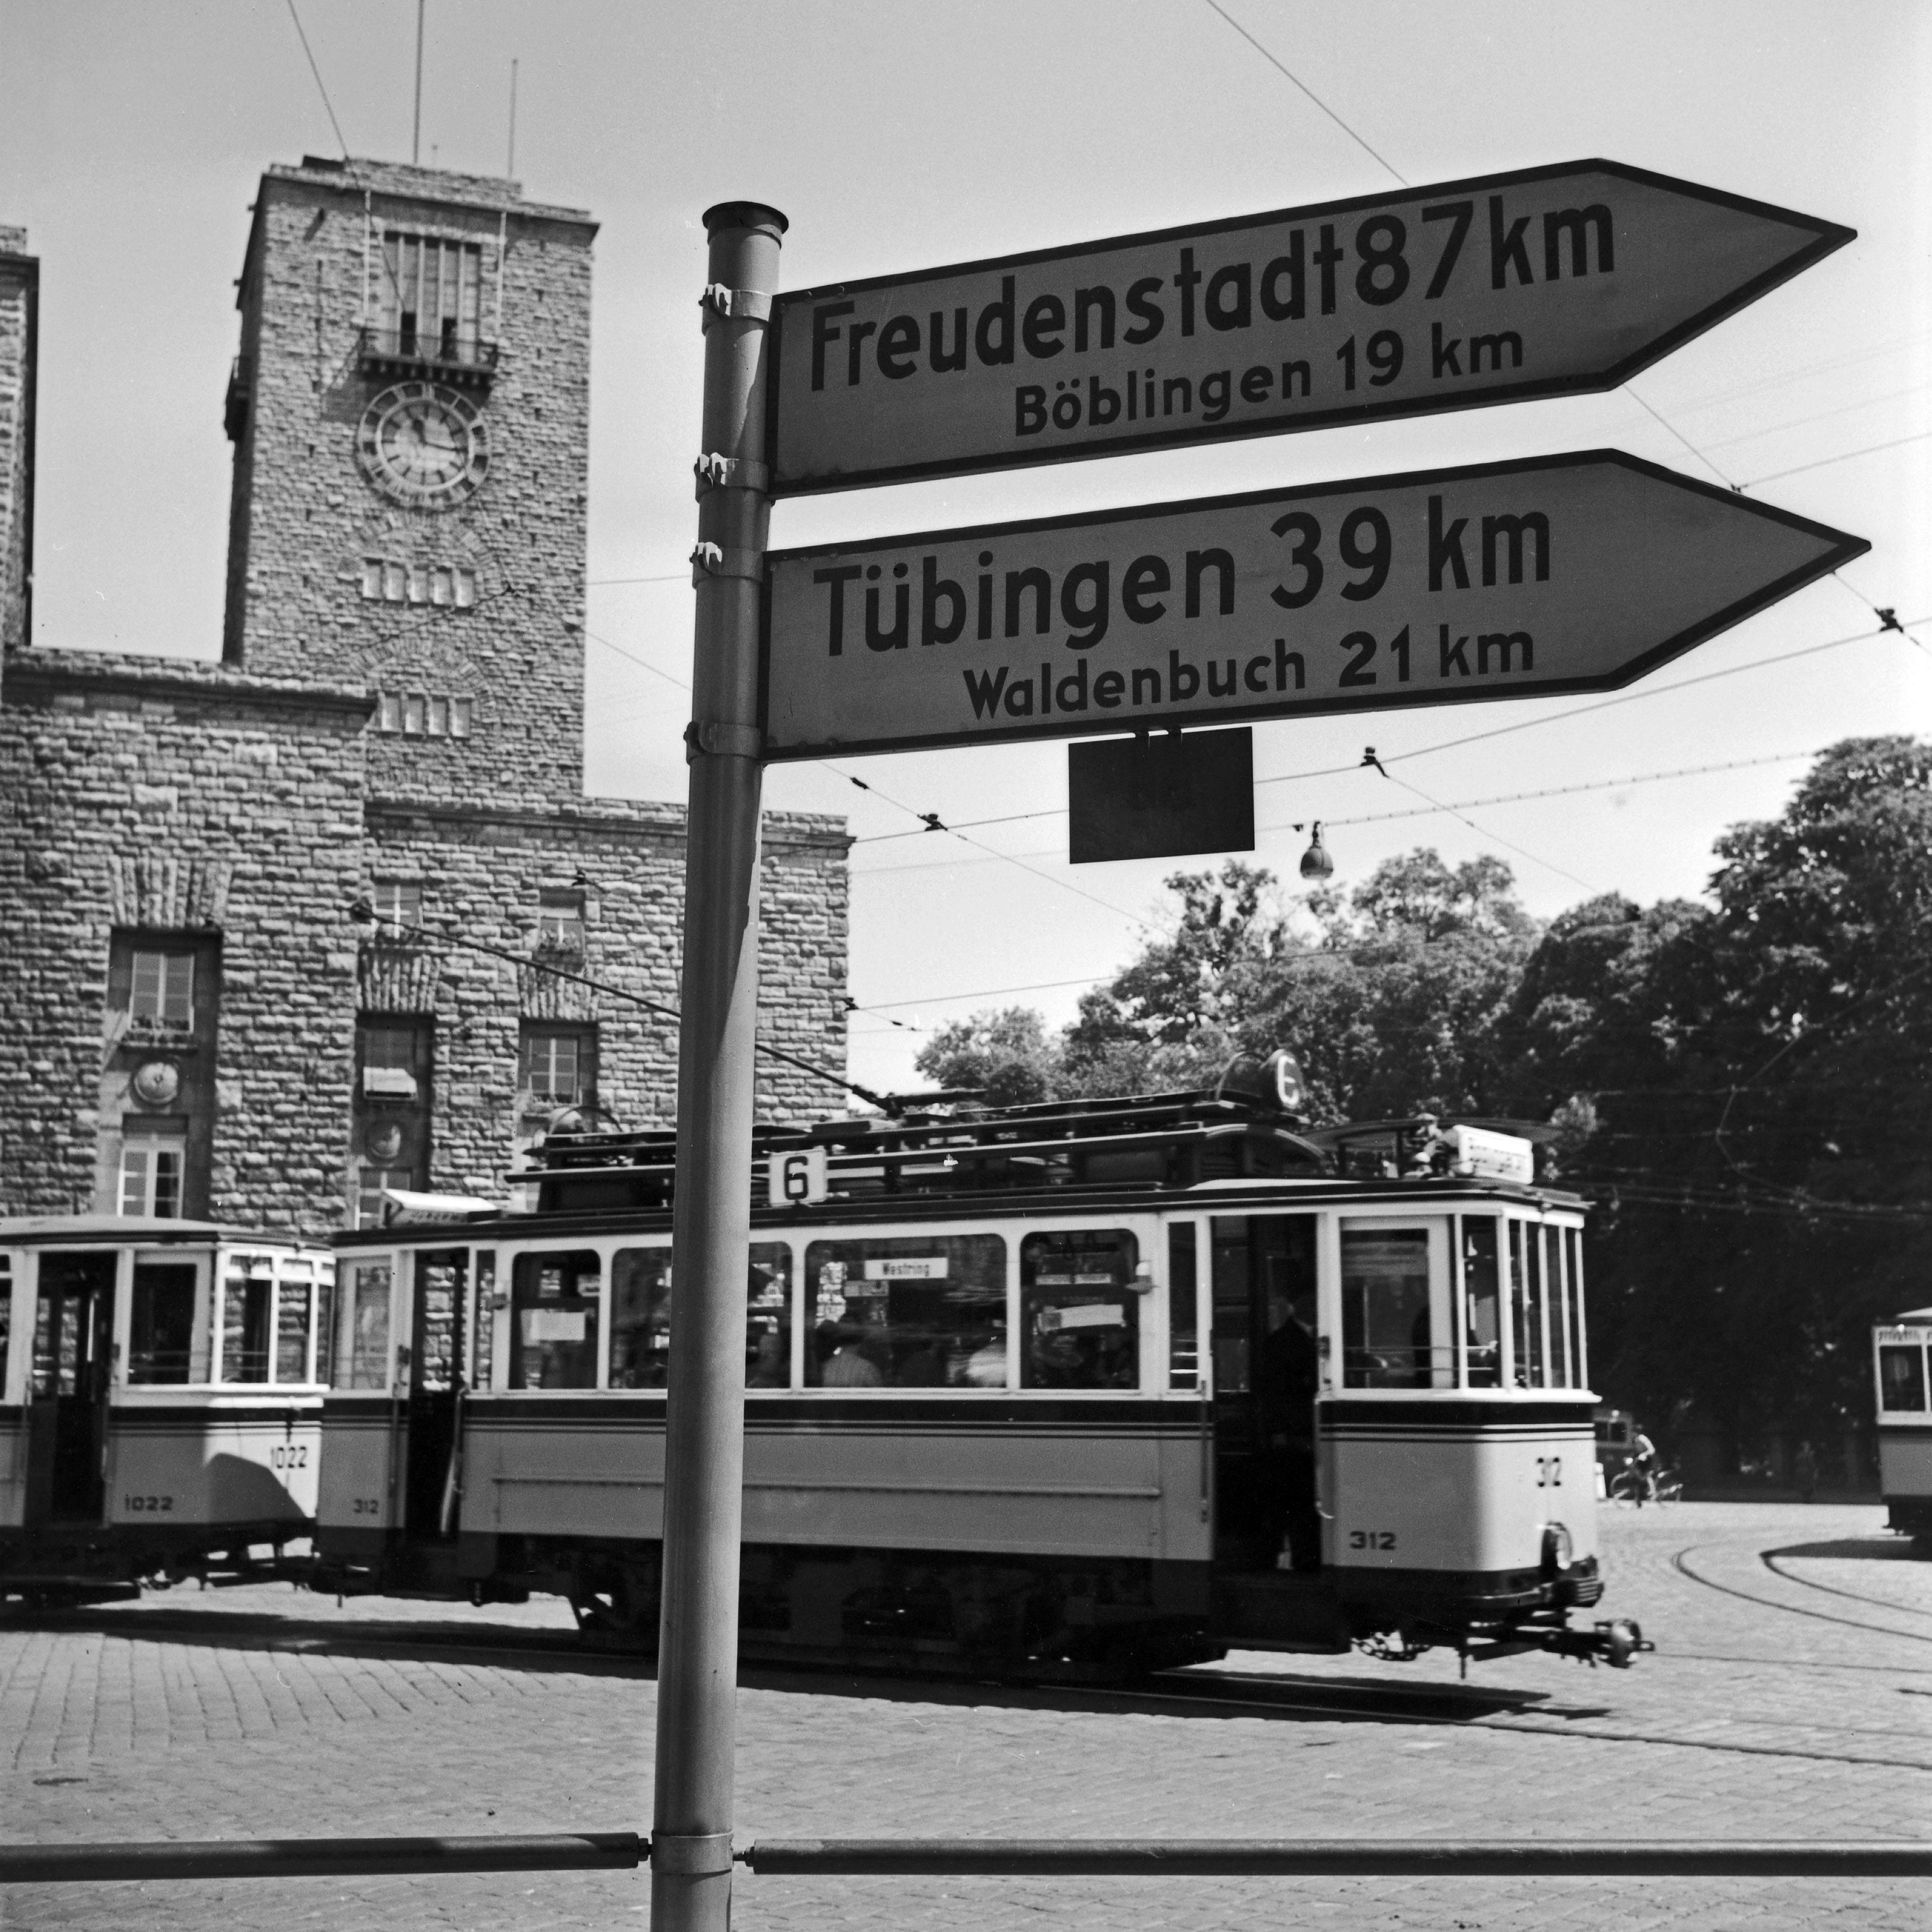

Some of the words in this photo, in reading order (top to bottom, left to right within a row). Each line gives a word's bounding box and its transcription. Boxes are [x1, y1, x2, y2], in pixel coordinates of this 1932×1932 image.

[811, 224, 1344, 392] Freudenstadt
[1355, 200, 1474, 306] 87
[1488, 194, 1615, 290] km
[1015, 360, 1311, 437] Böblingen
[1336, 329, 1404, 392] 19
[1431, 321, 1523, 379] km
[813, 548, 1235, 656] Tübingen
[1271, 506, 1392, 609] 39
[1428, 494, 1550, 592] km
[963, 638, 1305, 719] Waldenbuch
[1339, 625, 1410, 688] 21
[1439, 623, 1534, 678] km
[784, 1156, 808, 1199] 6
[271, 1446, 307, 1469] 1022
[125, 1494, 173, 1512] 1022
[354, 1499, 379, 1513] 312
[1349, 1531, 1396, 1551] 312
